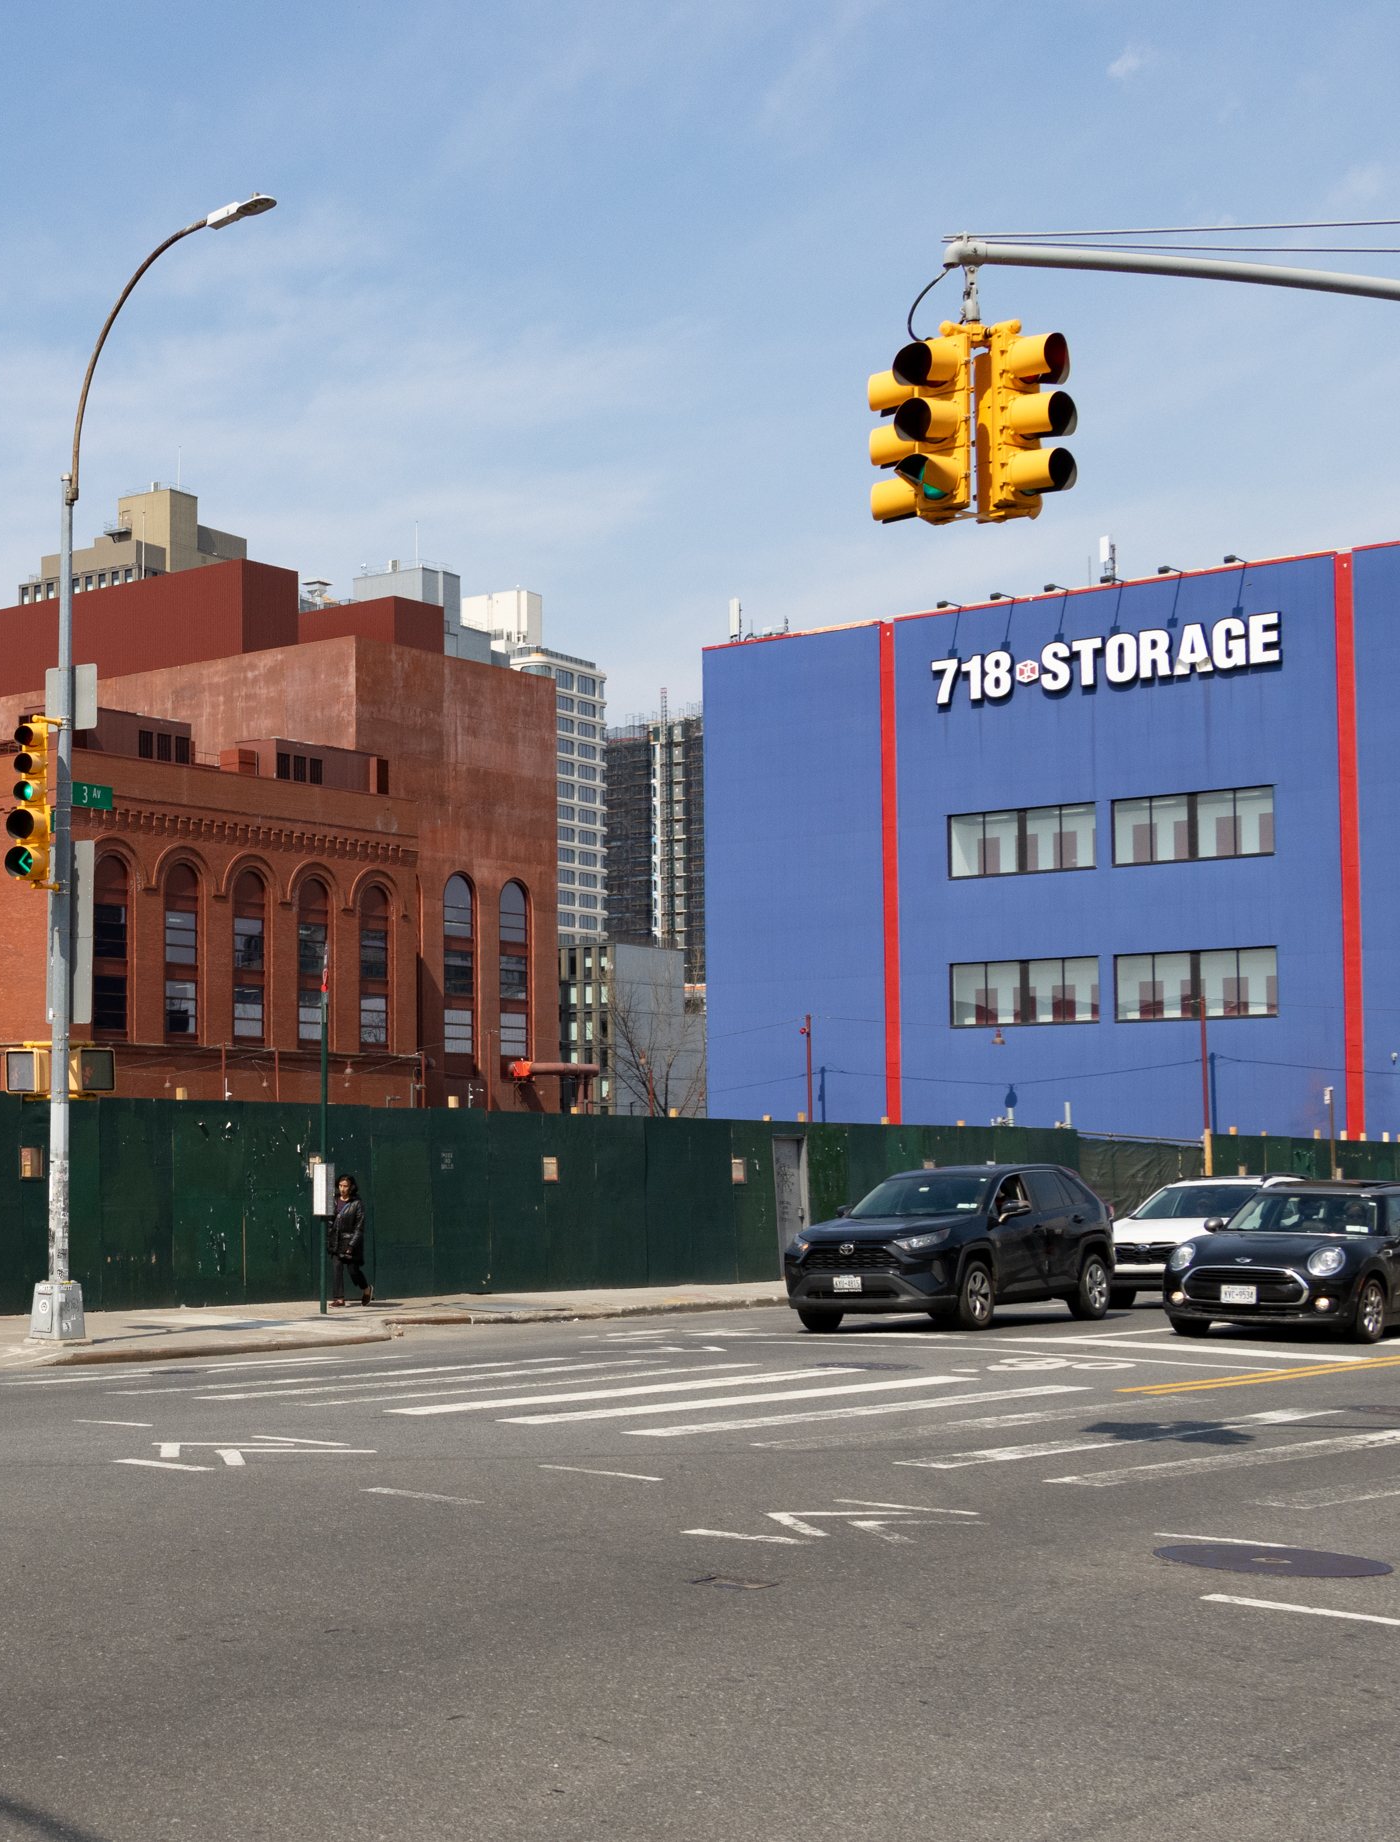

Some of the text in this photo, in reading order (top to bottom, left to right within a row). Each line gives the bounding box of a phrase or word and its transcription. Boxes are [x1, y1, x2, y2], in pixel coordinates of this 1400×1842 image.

[931, 611, 1281, 706] 718 STORAGE
[82, 786, 101, 803] 3 Av
